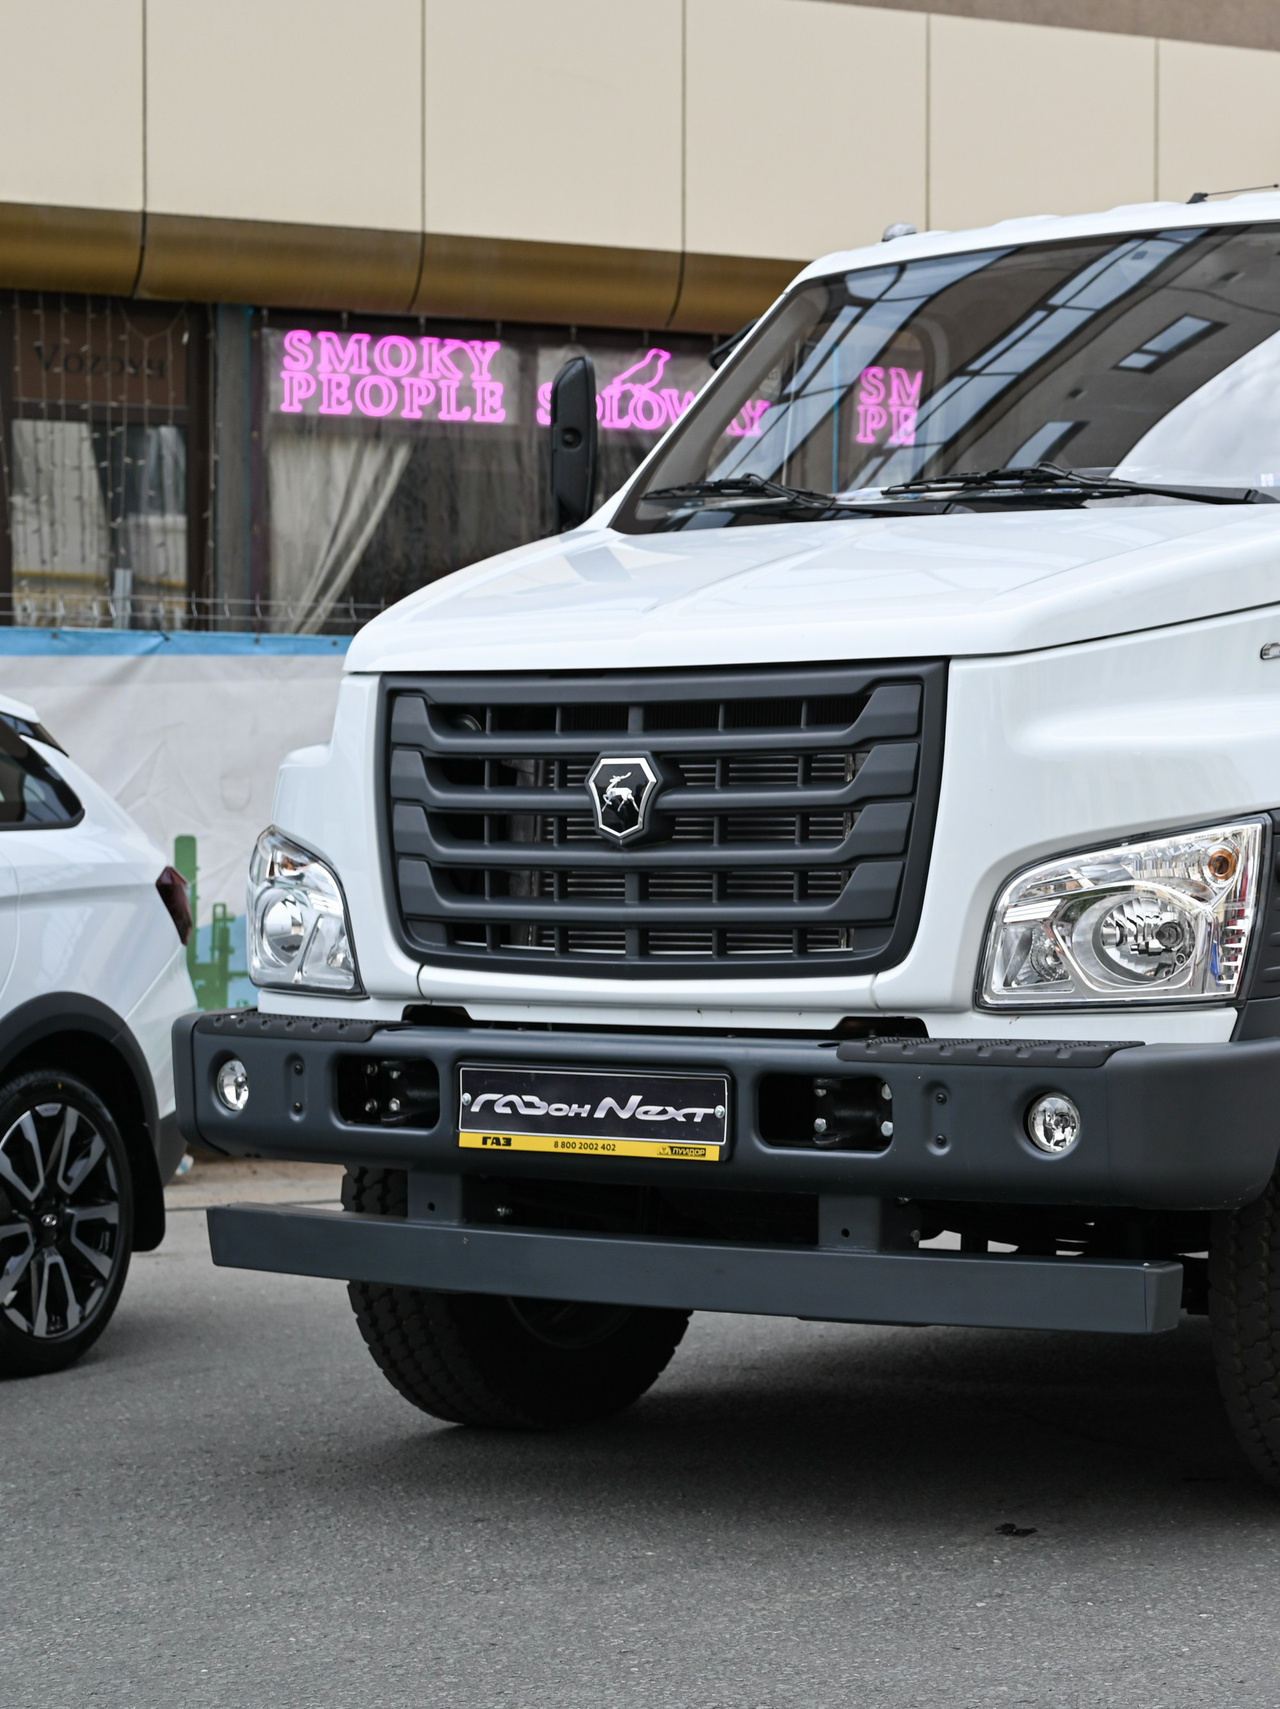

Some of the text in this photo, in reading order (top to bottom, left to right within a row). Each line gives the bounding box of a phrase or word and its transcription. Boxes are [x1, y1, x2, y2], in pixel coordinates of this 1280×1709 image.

[282, 329, 501, 382] SMOKY
[280, 370, 506, 423] PEOPLE
[481, 1136, 512, 1147] ГАЗ
[553, 1140, 616, 1152] 8 800 2002 402
